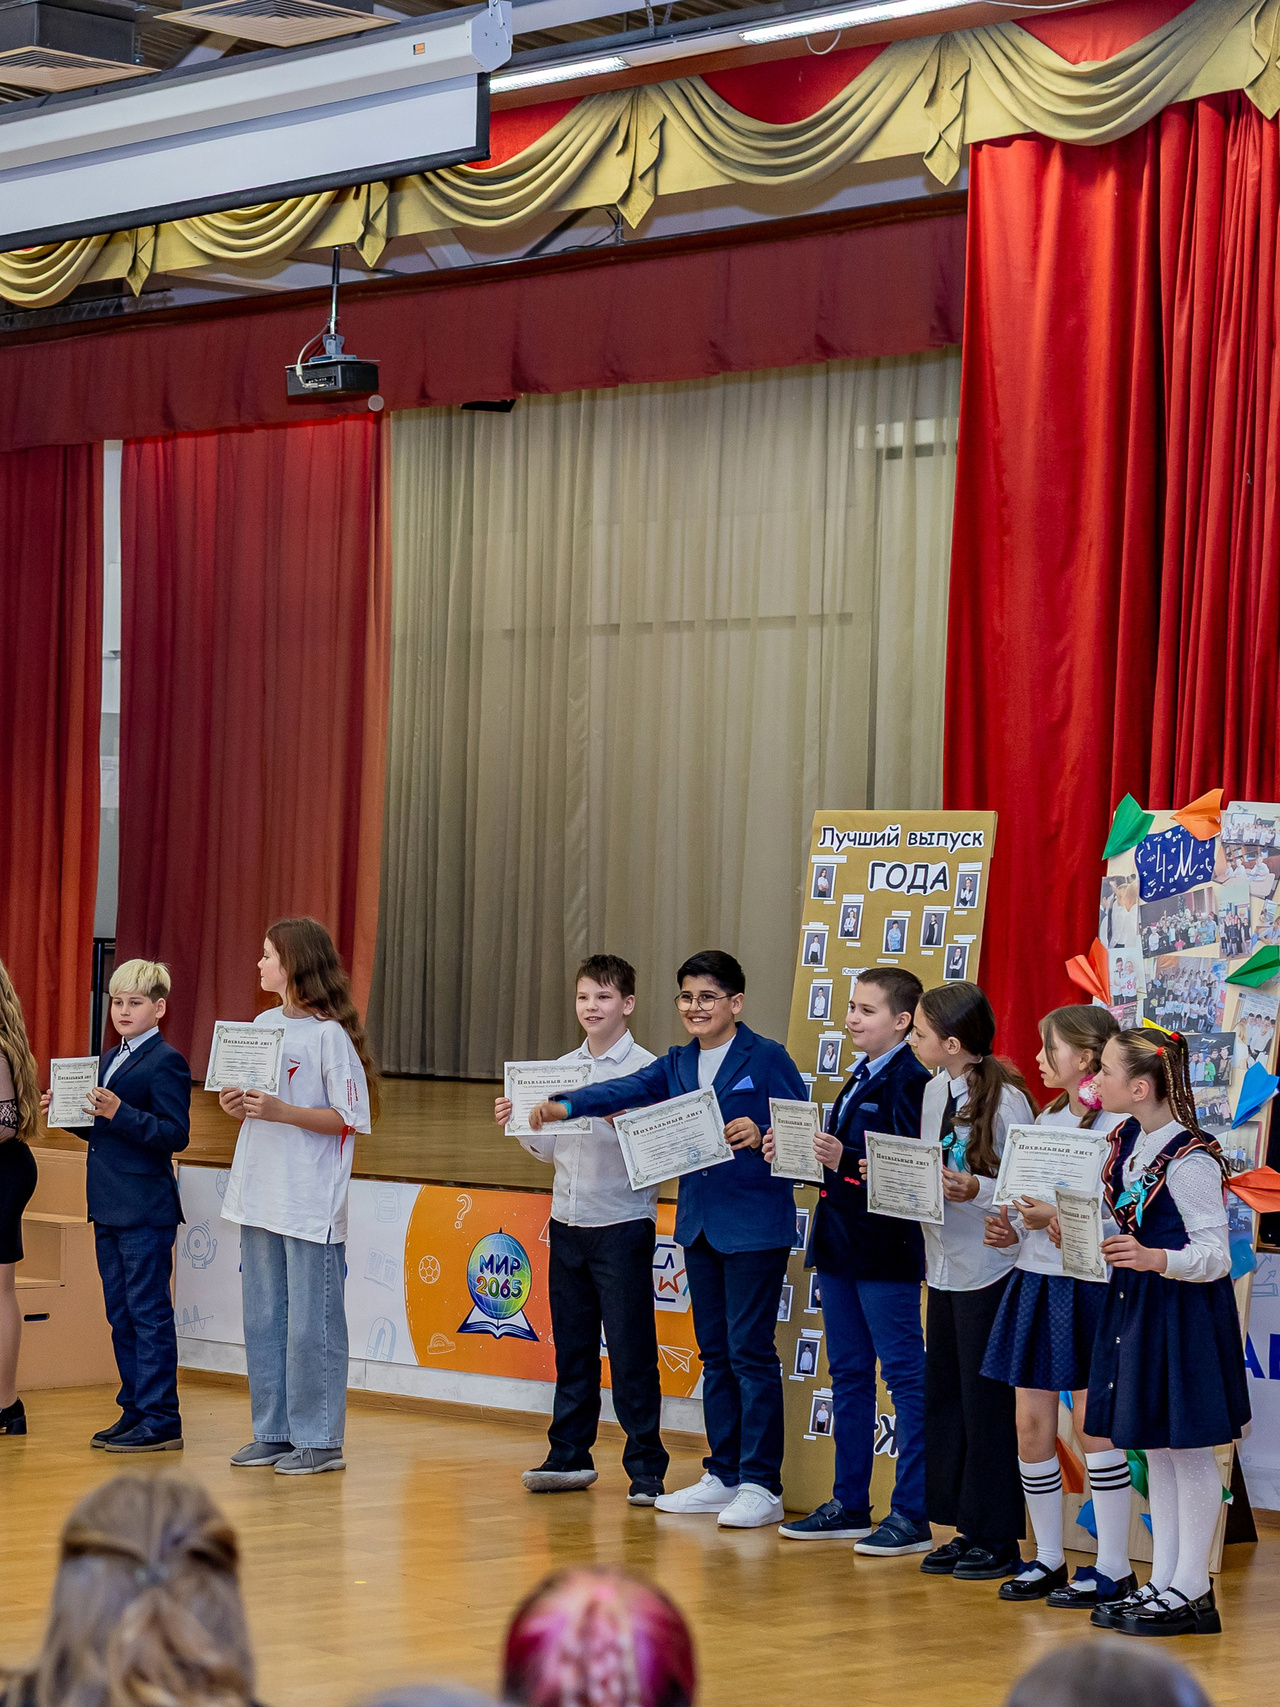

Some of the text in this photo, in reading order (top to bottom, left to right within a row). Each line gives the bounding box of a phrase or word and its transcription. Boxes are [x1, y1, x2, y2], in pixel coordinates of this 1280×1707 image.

[819, 825, 984, 853] Лучший выпуск
[869, 862, 949, 895] ГОДА
[632, 1115, 683, 1136] Похвальный
[685, 1110, 703, 1120] лист
[1018, 1144, 1071, 1154] Похвальный
[1073, 1149, 1094, 1157] лист
[479, 1253, 522, 1276] МИР
[476, 1275, 522, 1299] 2065
